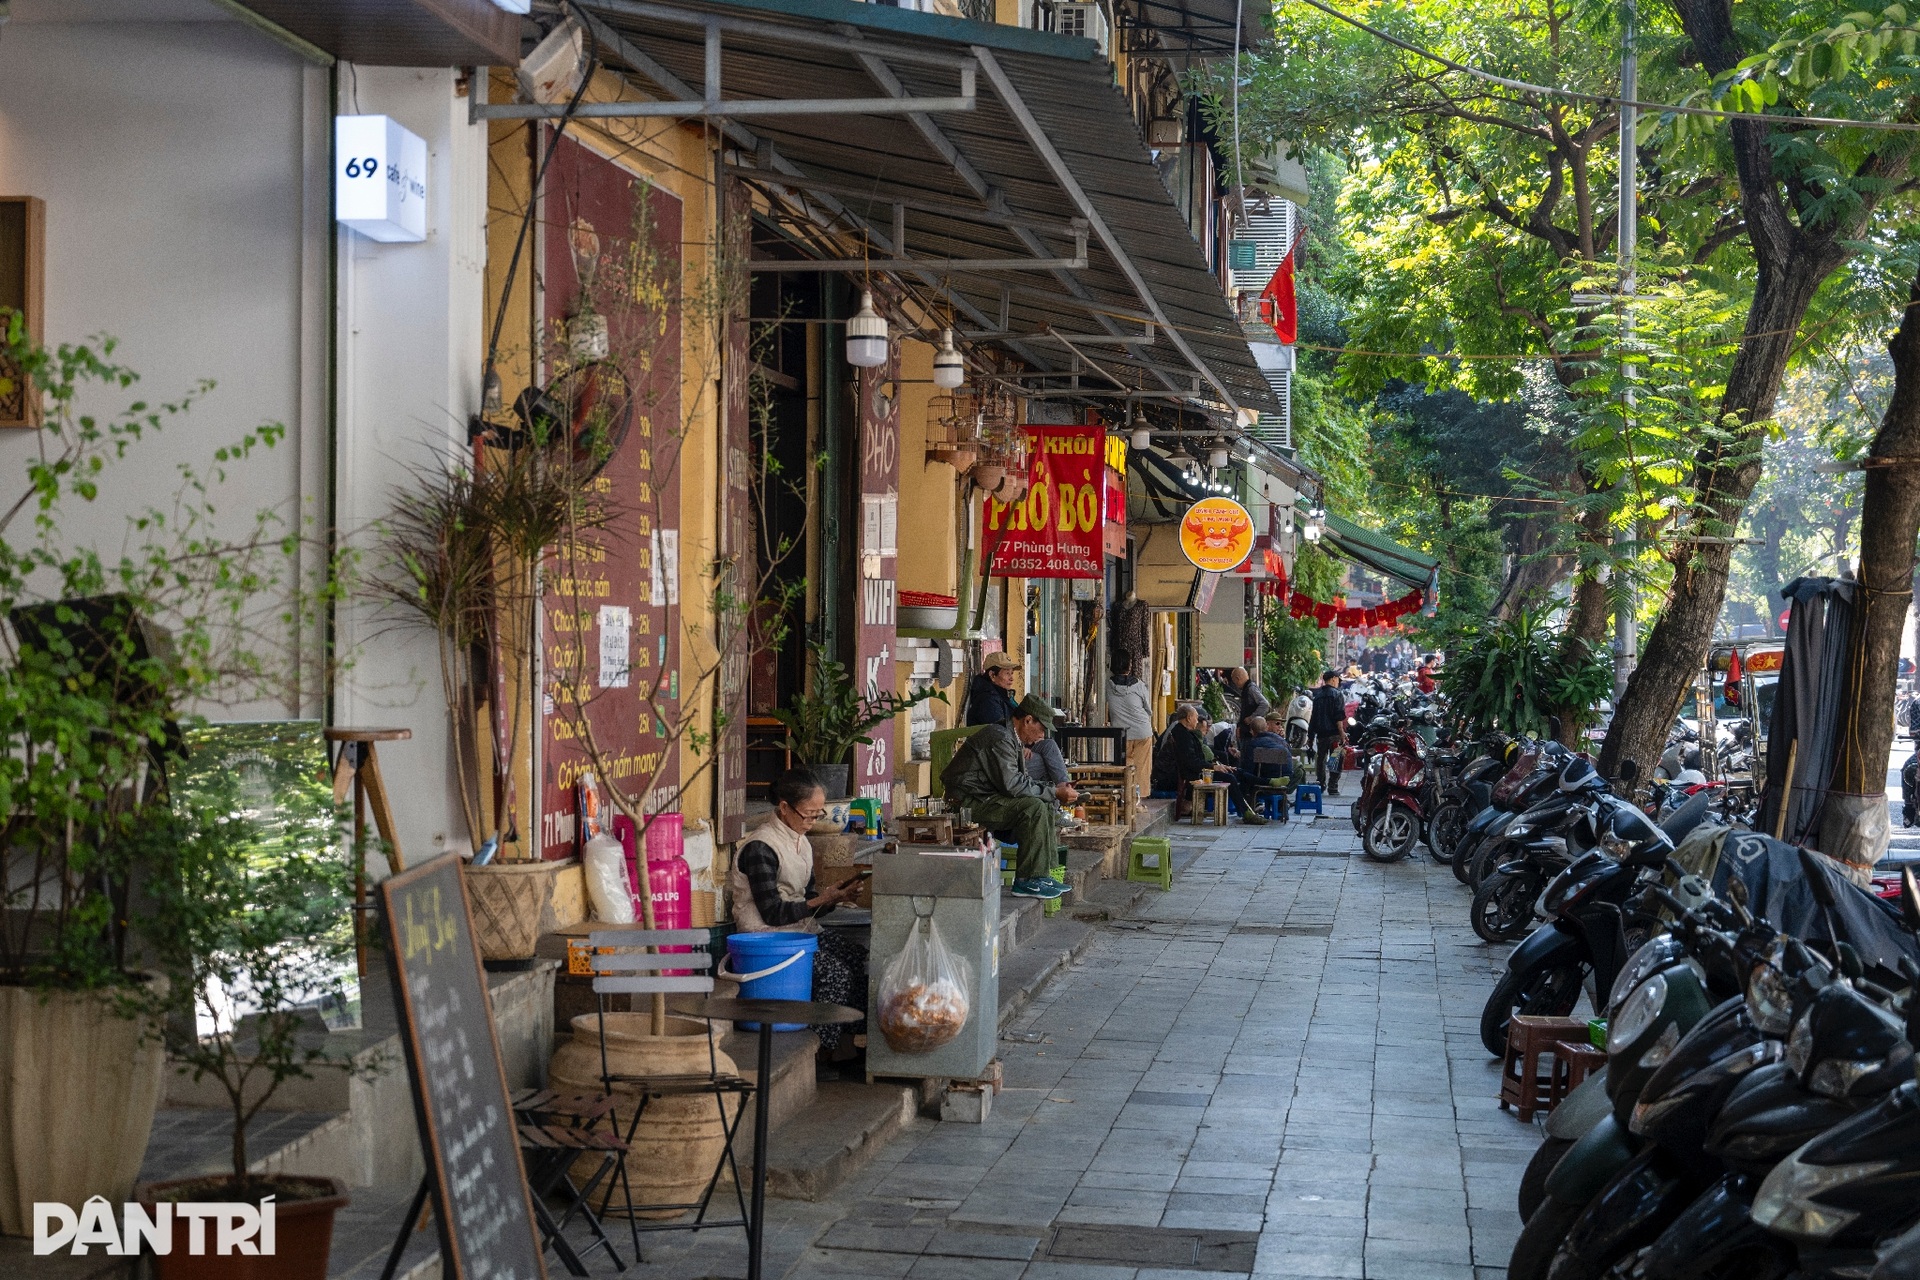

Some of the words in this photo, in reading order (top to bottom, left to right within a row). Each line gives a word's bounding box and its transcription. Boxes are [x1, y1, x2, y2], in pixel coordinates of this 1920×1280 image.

[345, 157, 379, 179] 69
[1044, 433, 1096, 456] KHÔI
[1058, 468, 1098, 534] BÒ
[1013, 540, 1054, 557] Phùng
[1057, 542, 1091, 557] Hưng
[1011, 558, 1098, 571] 0352.408.036
[864, 579, 895, 625] WIFI
[639, 614, 650, 635] 25k
[639, 646, 651, 668] 25k
[639, 713, 650, 734] 25k
[866, 738, 886, 777] 73
[558, 760, 572, 791] Có
[613, 747, 632, 779] nấm
[544, 813, 554, 848] 71
[650, 893, 662, 902] AS
[664, 892, 680, 901] LPG
